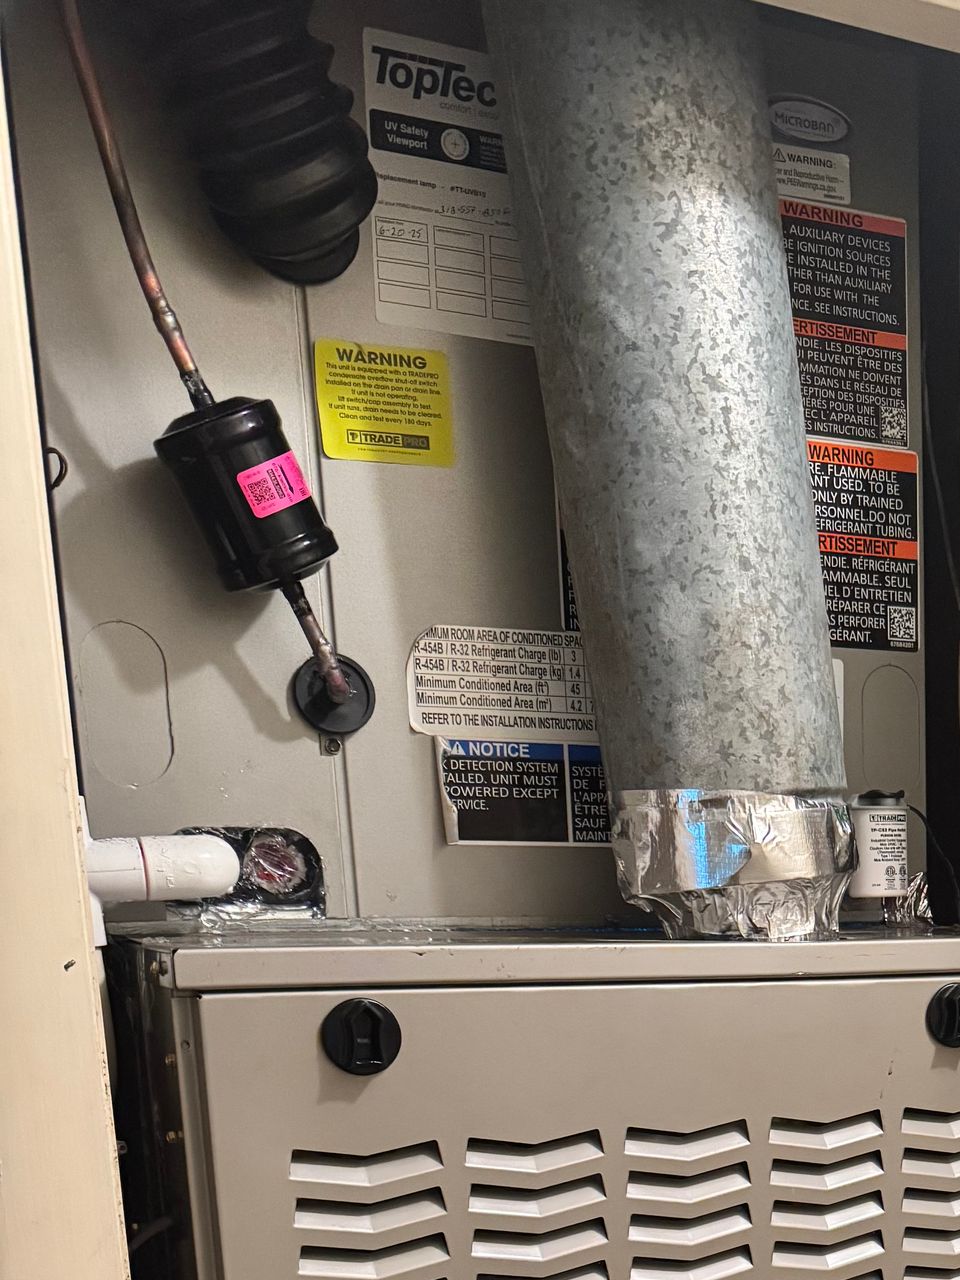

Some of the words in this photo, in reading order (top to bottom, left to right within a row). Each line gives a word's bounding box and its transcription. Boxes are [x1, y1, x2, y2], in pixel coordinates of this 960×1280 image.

[385, 121, 397, 130] UV
[401, 124, 428, 138] Safety
[387, 134, 428, 149] Viewport
[787, 153, 836, 169] WARNING:
[783, 201, 864, 228] WARNING
[790, 225, 844, 244] AUXILIARY
[848, 235, 890, 252] DEVICES
[797, 240, 843, 258] IGNITION
[846, 249, 891, 267] SOURCES
[797, 255, 853, 273] INSTALLED
[857, 265, 867, 276] IN
[871, 267, 890, 280] THE
[815, 271, 841, 285] THAN
[845, 276, 892, 294] AUXILIARY
[793, 282, 811, 295] FOR
[814, 286, 831, 298] USE
[834, 289, 858, 302] WITH
[863, 294, 880, 306] THE
[815, 302, 831, 314] SEE
[833, 305, 899, 325] INSTRUCTIONS.
[336, 348, 427, 369] WARNING
[825, 341, 842, 352] LES
[845, 344, 903, 361] DISPOSITIFS
[807, 350, 854, 366] PEUVENT
[858, 356, 880, 370] ÊTRE
[884, 362, 902, 373] DES
[329, 372, 366, 380] condensate
[357, 367, 387, 375] equipped
[408, 371, 439, 380] TRADEPRO
[848, 370, 860, 380] NE
[863, 372, 901, 385] DOIVENT
[814, 376, 839, 388] DANS
[841, 381, 851, 390] LE
[854, 381, 888, 396] RÉSEAU
[891, 387, 902, 397] DE
[382, 400, 411, 409] assembly
[837, 391, 853, 401] DES
[856, 393, 905, 409] DISPOSITIFS
[830, 402, 854, 413] POUR
[856, 406, 875, 416] UNE
[821, 409, 878, 427] L'APPAREIL
[814, 422, 878, 439] INSTRUCTIONS.
[809, 444, 874, 466] WARNING
[828, 464, 897, 484] FLAMMABLE
[833, 476, 866, 492] USED.
[868, 481, 884, 494] TO
[887, 483, 900, 496] BE
[841, 493, 854, 506] BY
[856, 495, 903, 510] TRAINED
[888, 513, 912, 526] NOT
[875, 525, 915, 539] TUBING.
[852, 556, 915, 574] RÉFRIGÉRANT
[885, 575, 911, 589] SEUL
[843, 586, 912, 603] D'ENTRETIEN
[873, 604, 886, 615] CE
[838, 615, 886, 629] PERFORER
[451, 628, 475, 641] ROOM
[476, 629, 498, 642] AREA
[500, 632, 510, 643] OF
[511, 632, 563, 646] CONDITIONED
[414, 641, 443, 654] R-454B
[450, 643, 469, 655] R-32
[471, 644, 516, 660] Refrigerant
[518, 647, 546, 663] Charge
[549, 650, 562, 662] (lb)
[571, 652, 577, 663] 3
[415, 657, 445, 672] R-454B
[452, 659, 470, 673] R-32
[472, 661, 518, 677] Refrigerant
[519, 664, 548, 680] Charge
[549, 666, 564, 681] (kg)
[569, 666, 580, 679] 1.4
[416, 674, 457, 689] Minimum
[459, 678, 511, 693] Conditioned
[513, 680, 533, 694] Area
[570, 684, 580, 695] 45
[417, 691, 457, 705] Minimum
[459, 694, 512, 709] Conditioned
[514, 697, 534, 710] Area
[570, 700, 582, 712] 4.2
[422, 711, 449, 725] REFER
[450, 713, 462, 726] TO
[463, 713, 479, 727] THE
[480, 715, 536, 729] INSTALLATION
[538, 717, 593, 731] INSTRUCTIONS
[469, 741, 530, 758] NOTICE
[451, 760, 514, 773] DETECTION
[516, 762, 559, 774] SYSTEM
[490, 774, 520, 785] UNIT
[524, 775, 558, 786] MUST
[574, 779, 589, 790] DE
[513, 787, 560, 799] EXCEPT
[575, 818, 606, 828] SAUF
